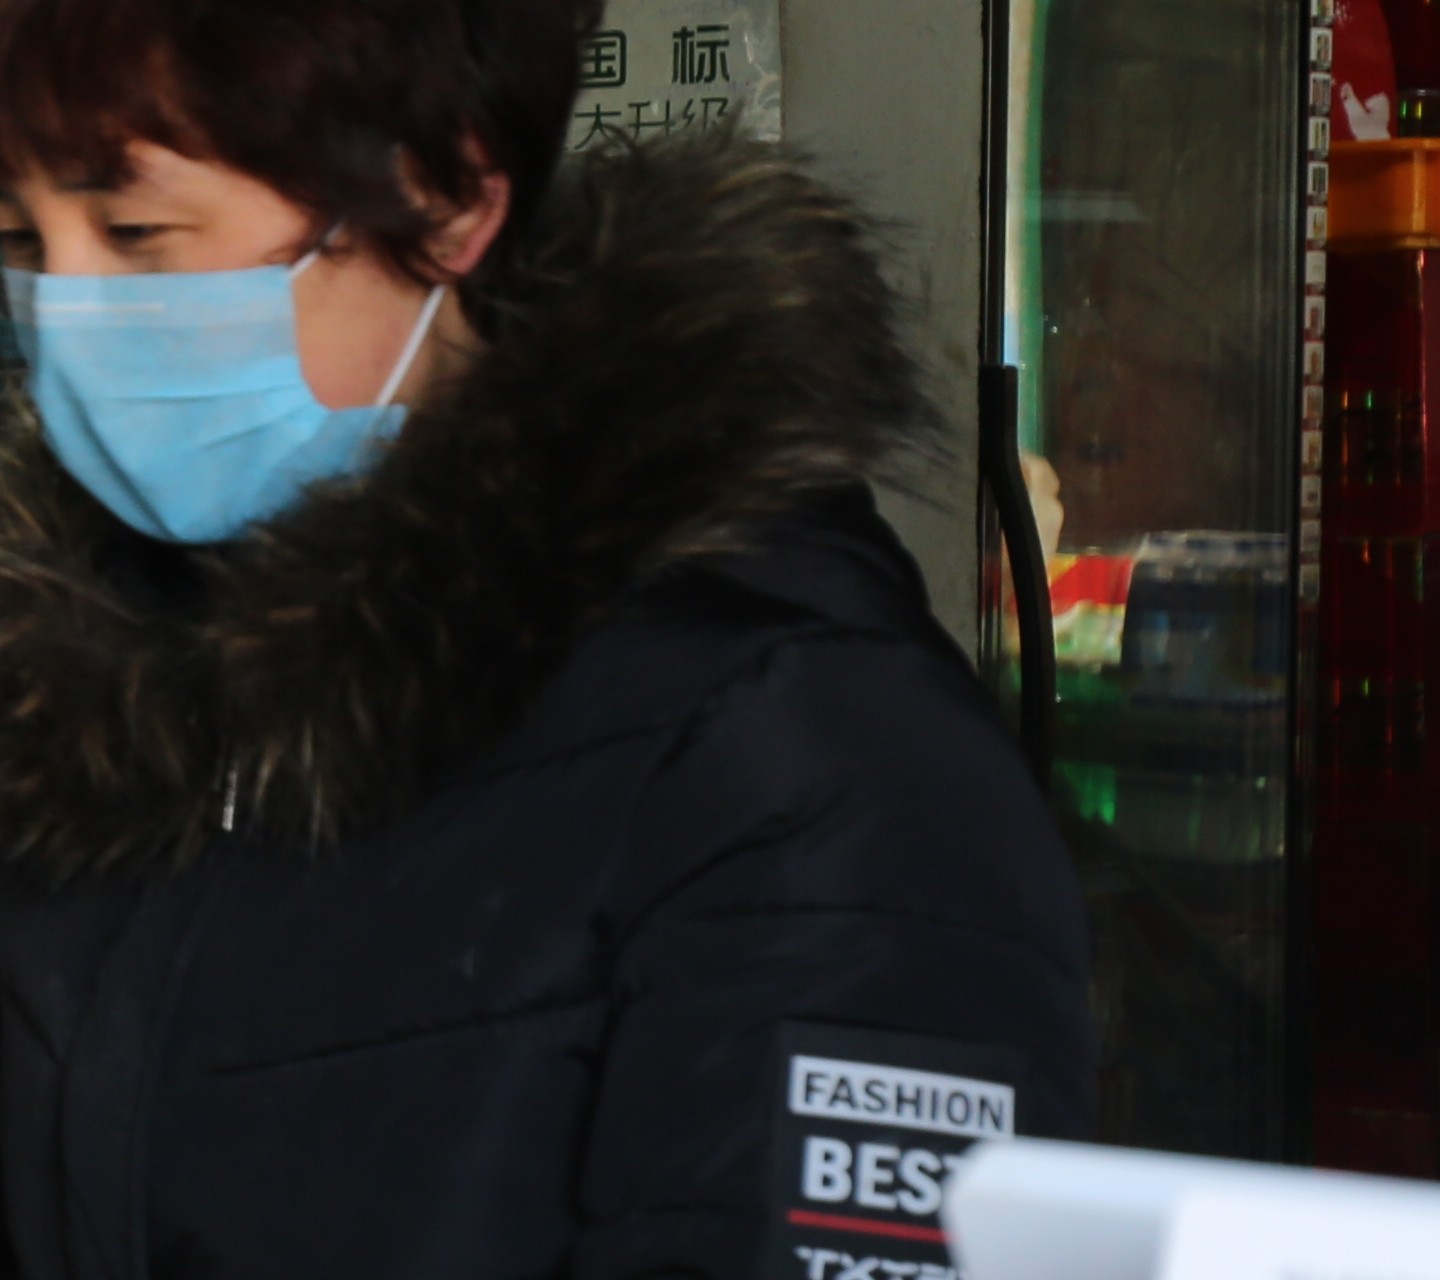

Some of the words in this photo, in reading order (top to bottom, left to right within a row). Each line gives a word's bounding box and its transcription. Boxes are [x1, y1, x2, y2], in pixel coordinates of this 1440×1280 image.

[578, 24, 731, 89] 国标
[803, 1072, 1005, 1132] FASHION
[801, 1135, 966, 1216] BES
